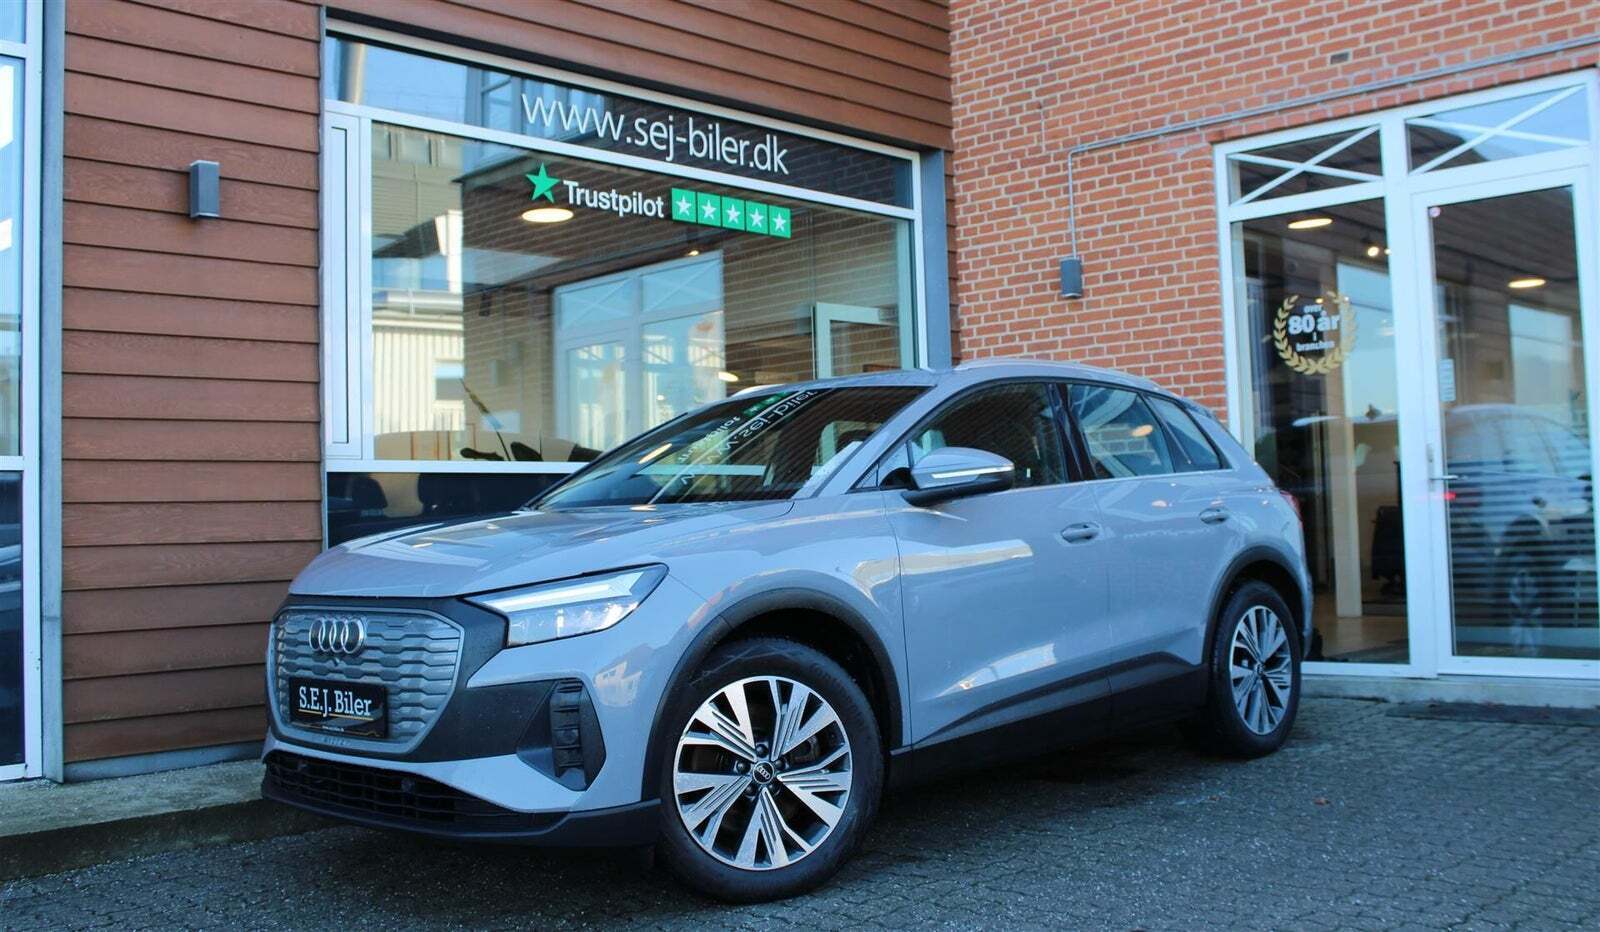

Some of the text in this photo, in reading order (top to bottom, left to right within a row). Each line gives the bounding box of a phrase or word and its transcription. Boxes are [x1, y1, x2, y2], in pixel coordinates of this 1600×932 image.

[521, 94, 789, 175] www.sej-biler.dk
[563, 180, 664, 218] Trustpilot
[1288, 310, 1340, 334] 80 år
[298, 686, 372, 718] S.E.J. Biler
